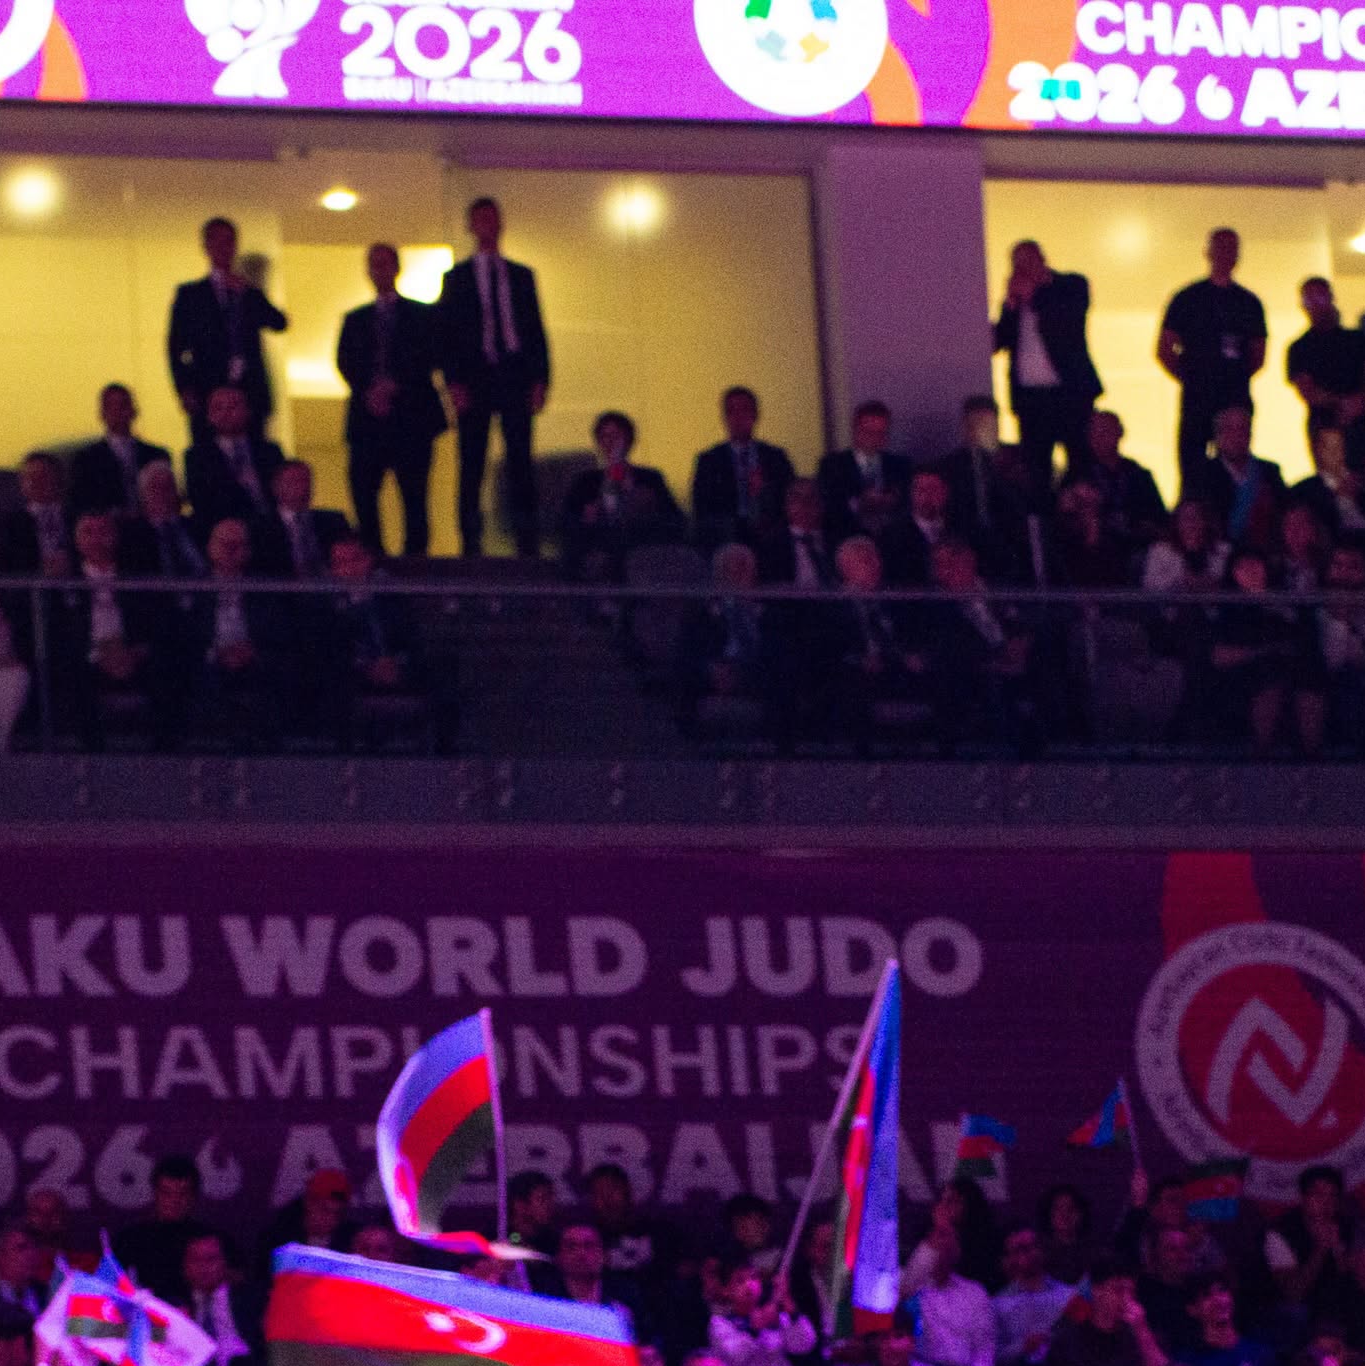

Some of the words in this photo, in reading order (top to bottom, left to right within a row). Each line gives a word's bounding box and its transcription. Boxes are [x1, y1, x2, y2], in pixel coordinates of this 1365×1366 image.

[339, 3, 583, 83] 2026
[1008, 61, 1186, 125] 2026
[221, 914, 648, 997] WORLD
[681, 915, 983, 998] JUDO
[270, 1121, 1011, 1207] ARBAIJN
